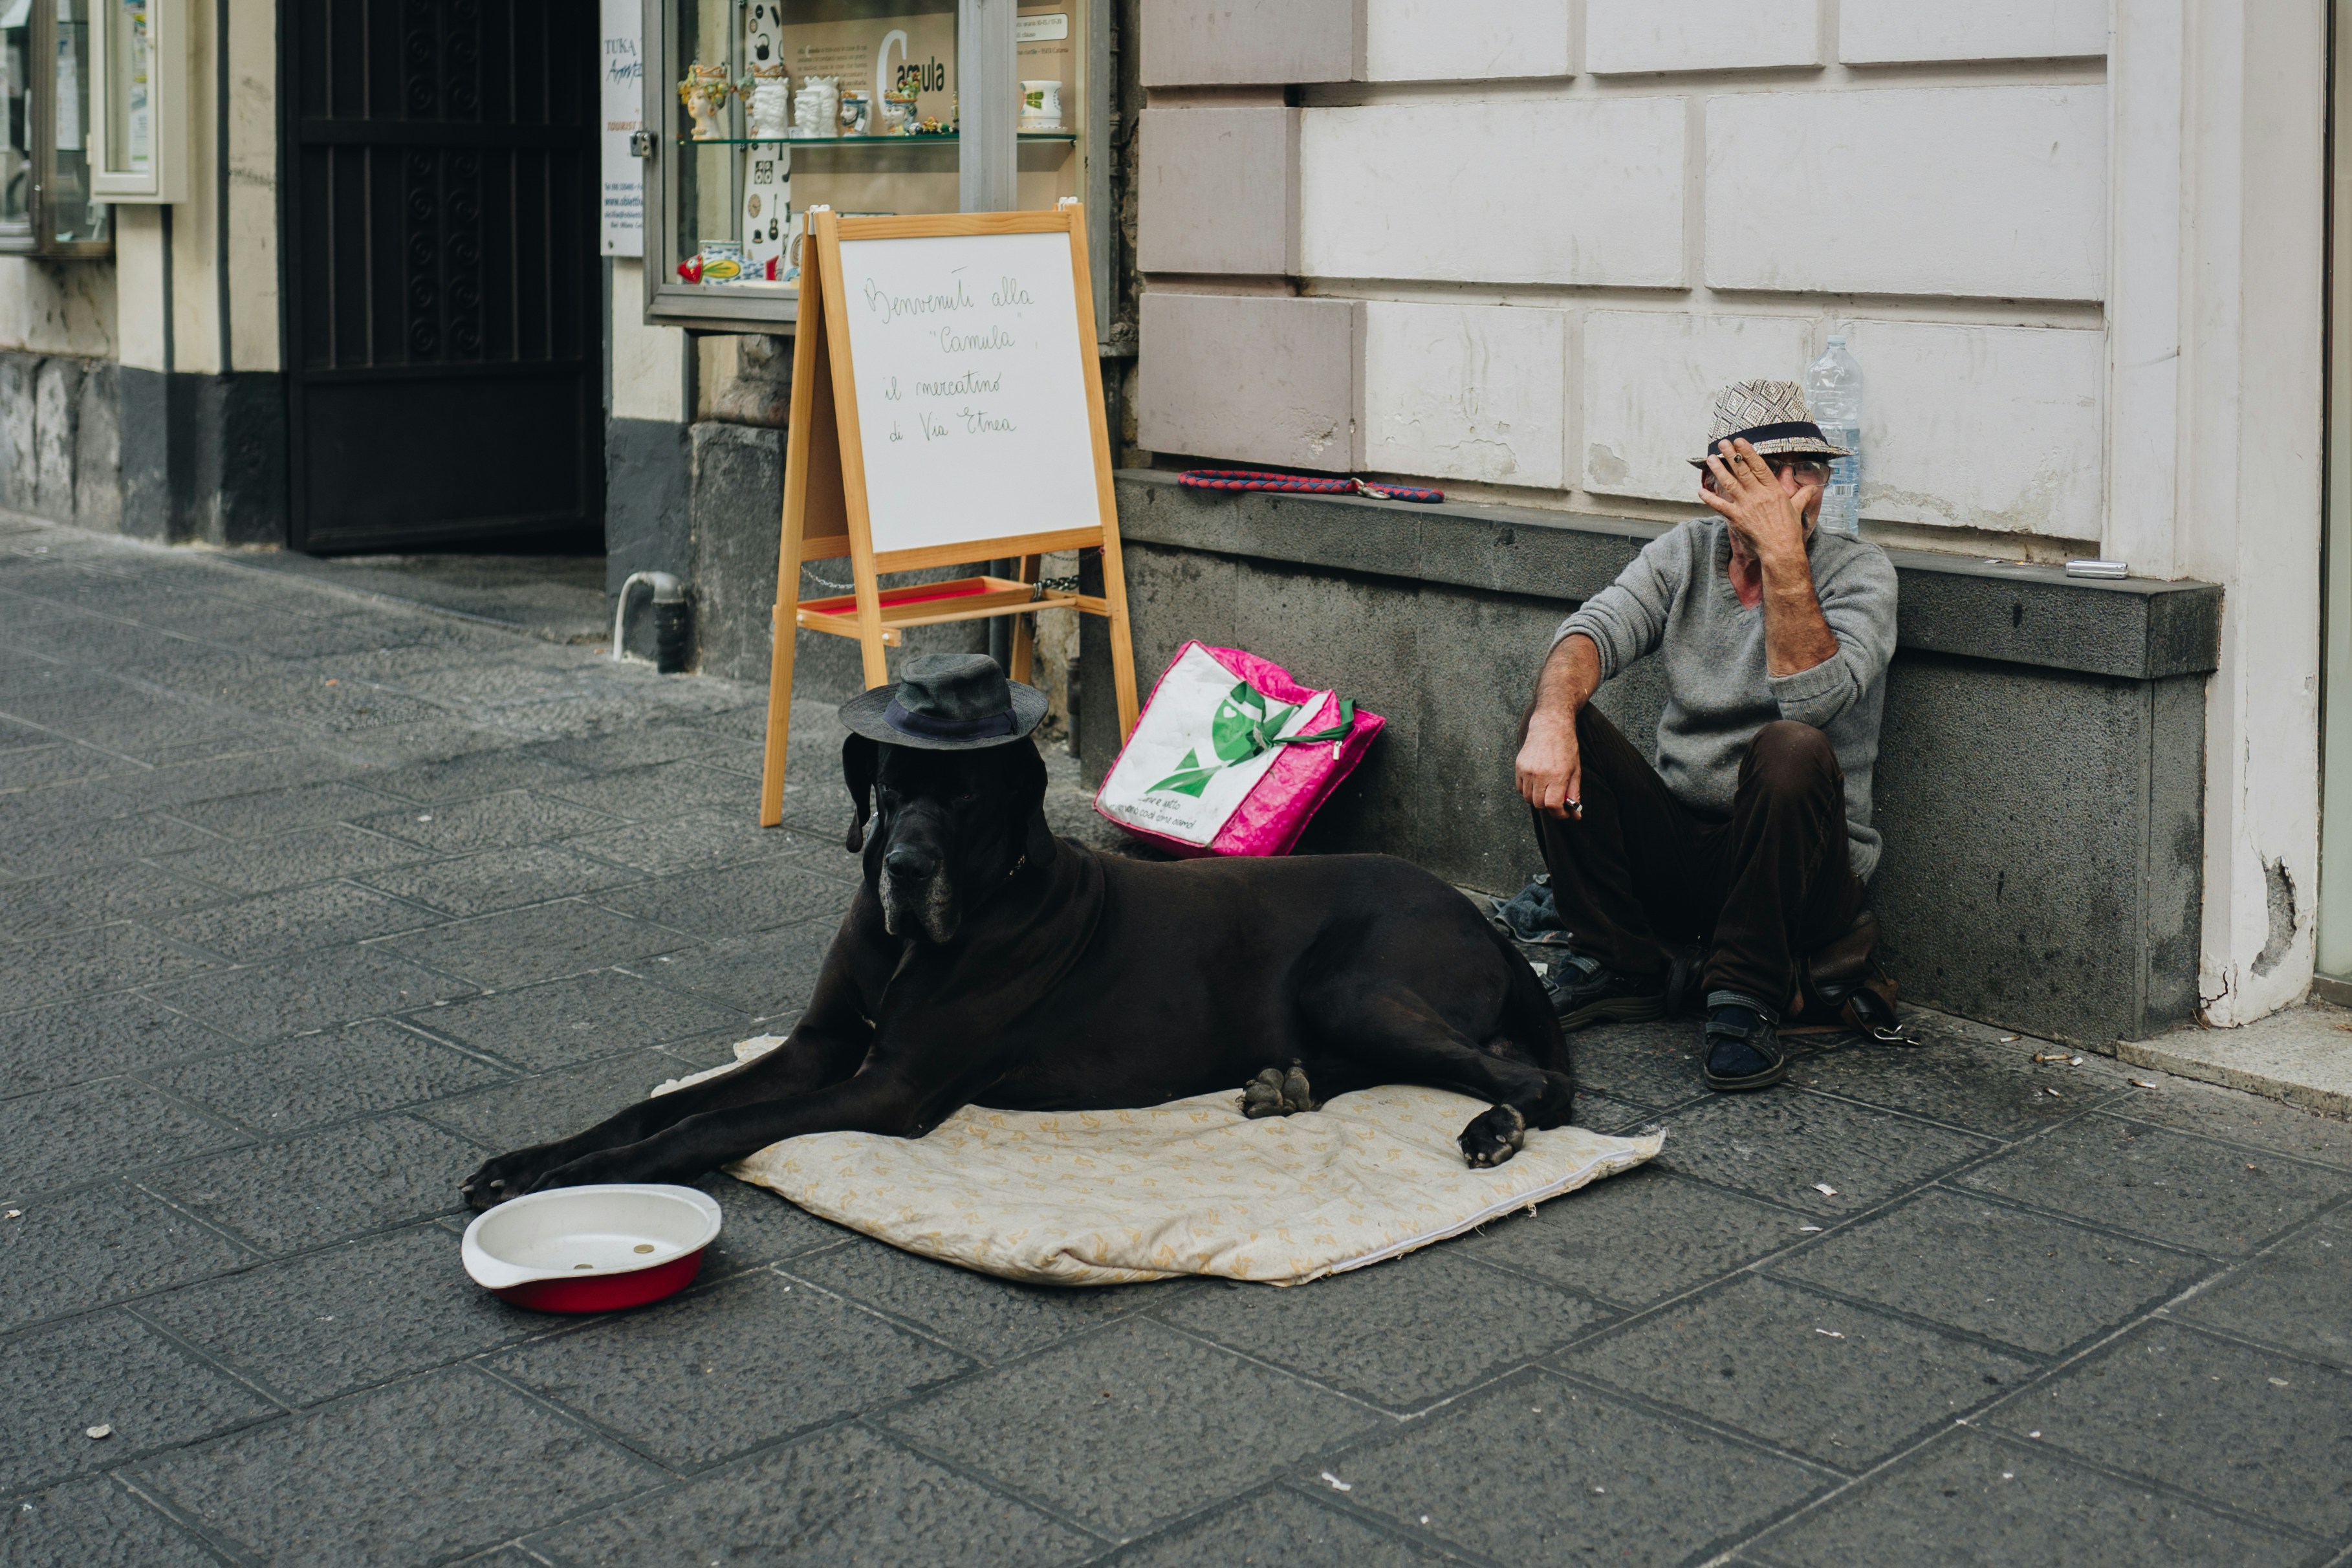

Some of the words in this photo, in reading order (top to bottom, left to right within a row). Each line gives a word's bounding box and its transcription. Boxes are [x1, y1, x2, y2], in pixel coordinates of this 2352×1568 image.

[605, 38, 637, 56] TUKA
[864, 266, 974, 324] Benvenuti
[992, 276, 1034, 307] alla
[882, 376, 902, 400] il
[916, 369, 1002, 396] mercatino
[889, 420, 904, 442] di
[919, 411, 949, 441] Via
[956, 406, 1018, 434] Etnea
